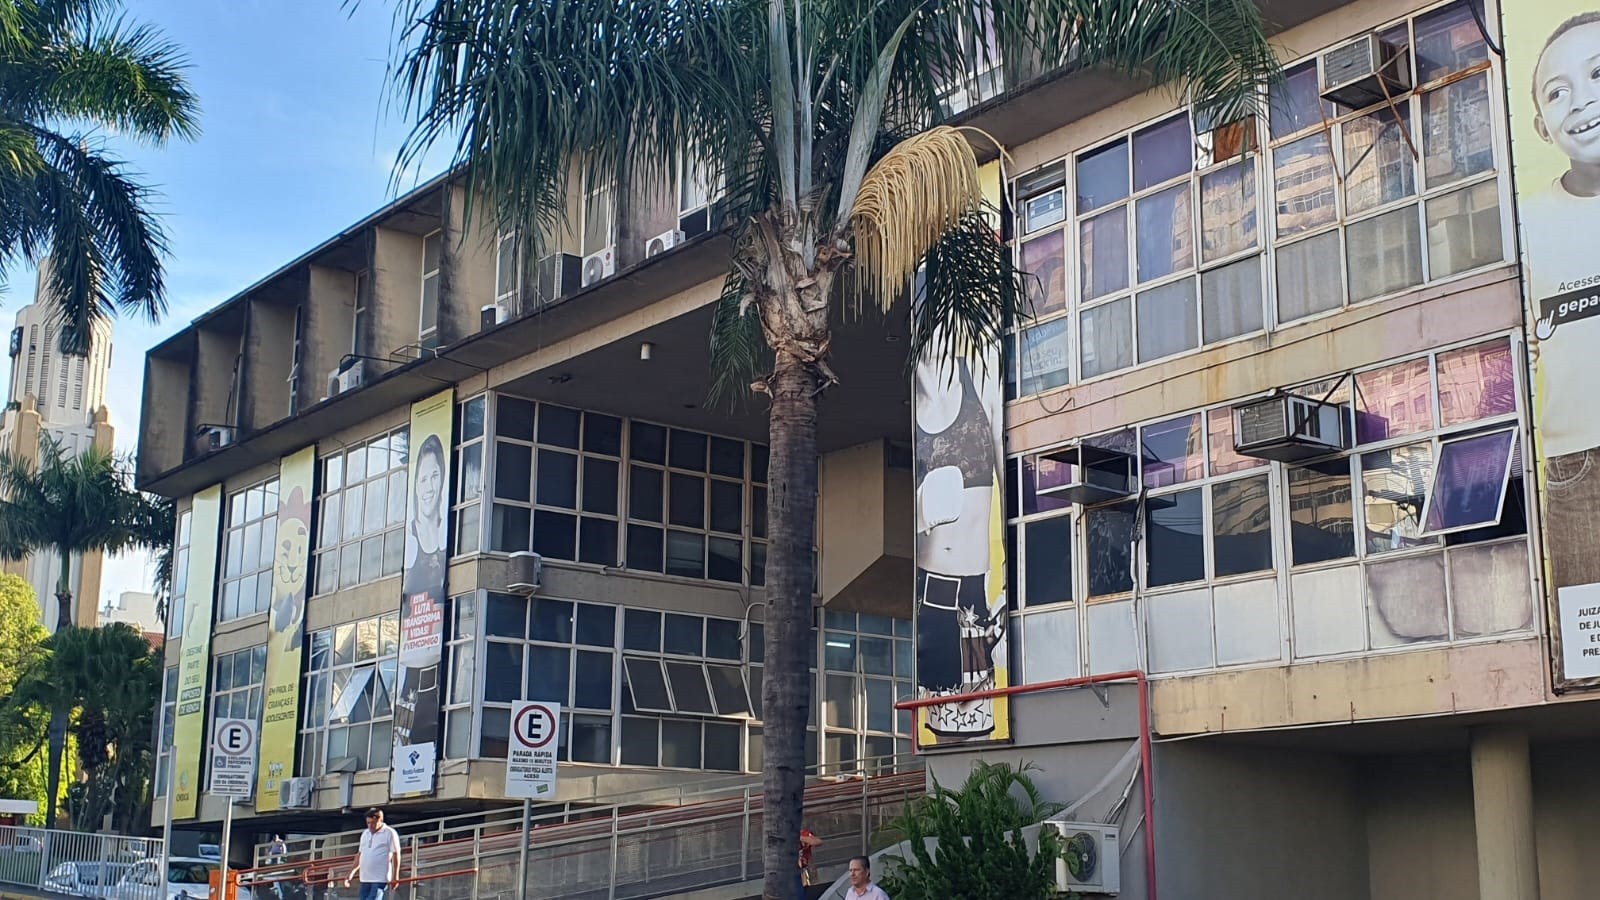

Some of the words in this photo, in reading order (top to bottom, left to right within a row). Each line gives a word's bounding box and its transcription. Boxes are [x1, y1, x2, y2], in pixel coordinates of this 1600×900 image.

[1558, 274, 1600, 292] Acesse
[1558, 295, 1600, 317] gepa
[414, 600, 432, 615] LUTA
[403, 610, 441, 629] TRANSFORMA
[1579, 622, 1592, 630] DE
[403, 636, 439, 651] #VEMCOMIGO
[265, 710, 295, 723] ADOLESCENTES
[528, 713, 542, 739] E
[229, 728, 241, 748] E
[512, 750, 532, 758] PARADA
